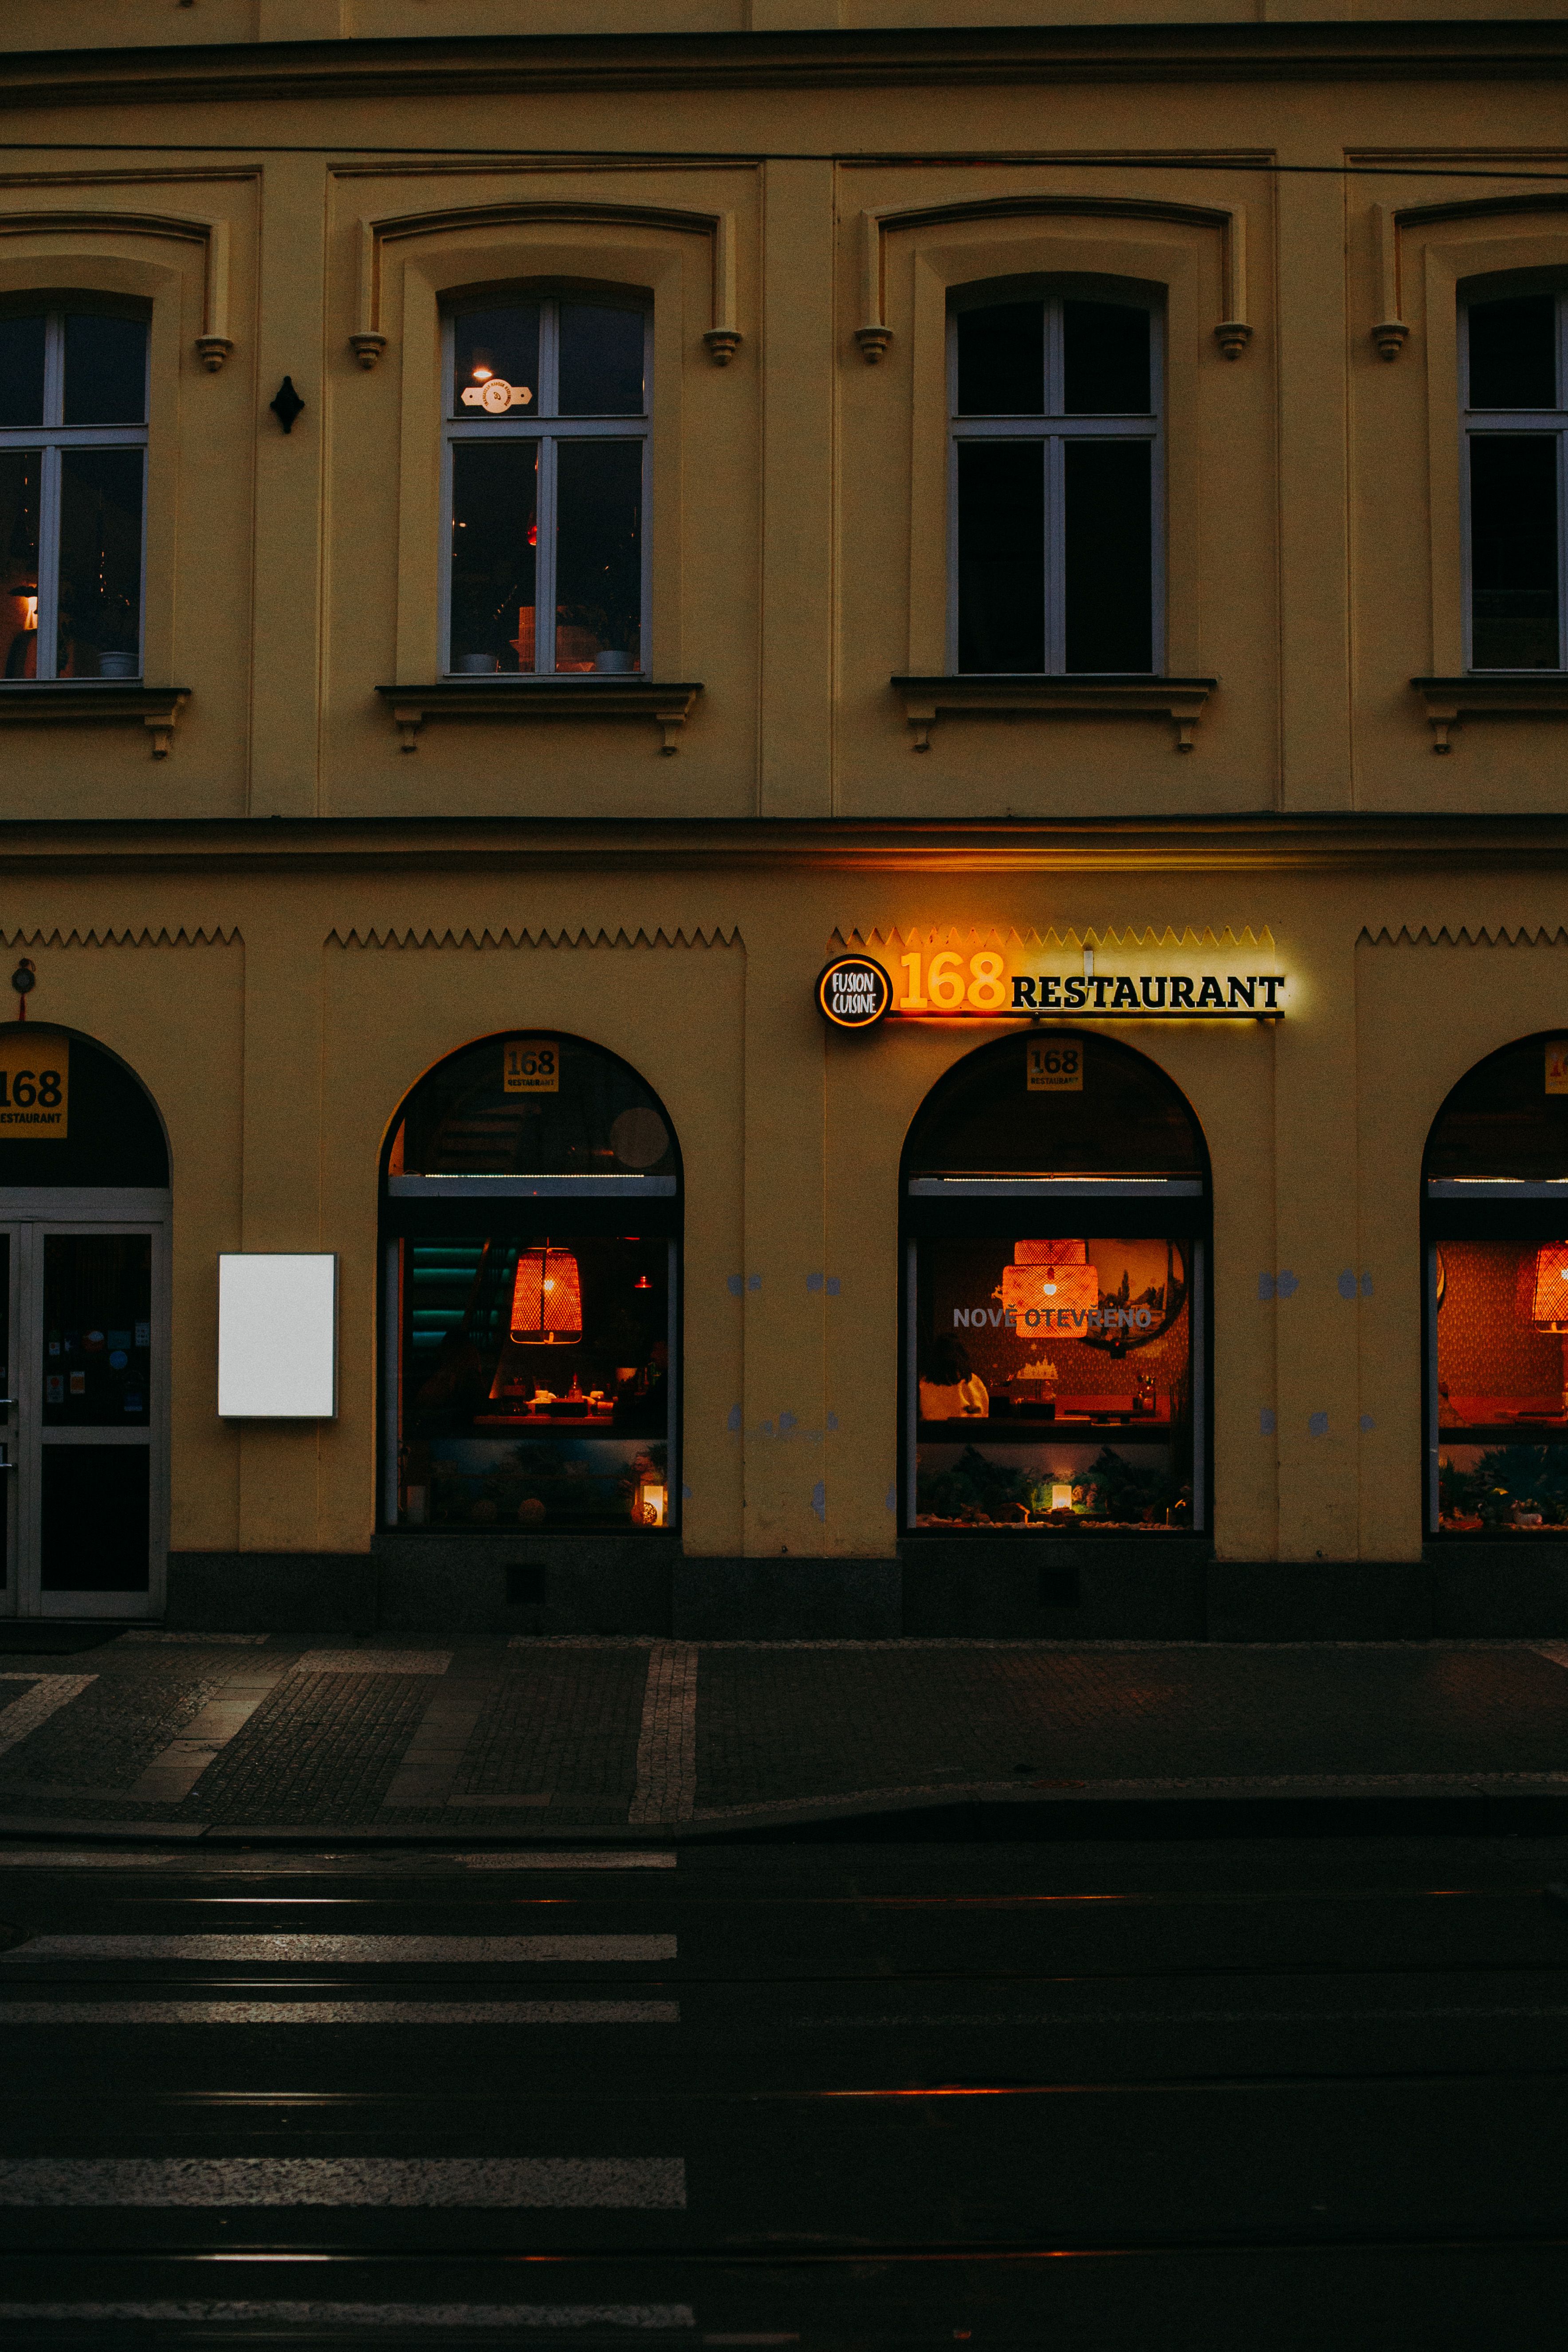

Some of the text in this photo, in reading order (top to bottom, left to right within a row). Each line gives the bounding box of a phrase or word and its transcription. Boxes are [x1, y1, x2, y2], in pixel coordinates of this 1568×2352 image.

[833, 972, 874, 992] FUSION
[900, 952, 1285, 1009] 168 RESTAURANT
[833, 993, 876, 1014] CUISINE
[508, 1051, 554, 1075] 168
[1031, 1050, 1078, 1074] 168
[0, 1070, 62, 1108] 168
[0, 1113, 61, 1123] ESTAURANT
[953, 1304, 1151, 1328] NOVĚ OTEVŘENO
